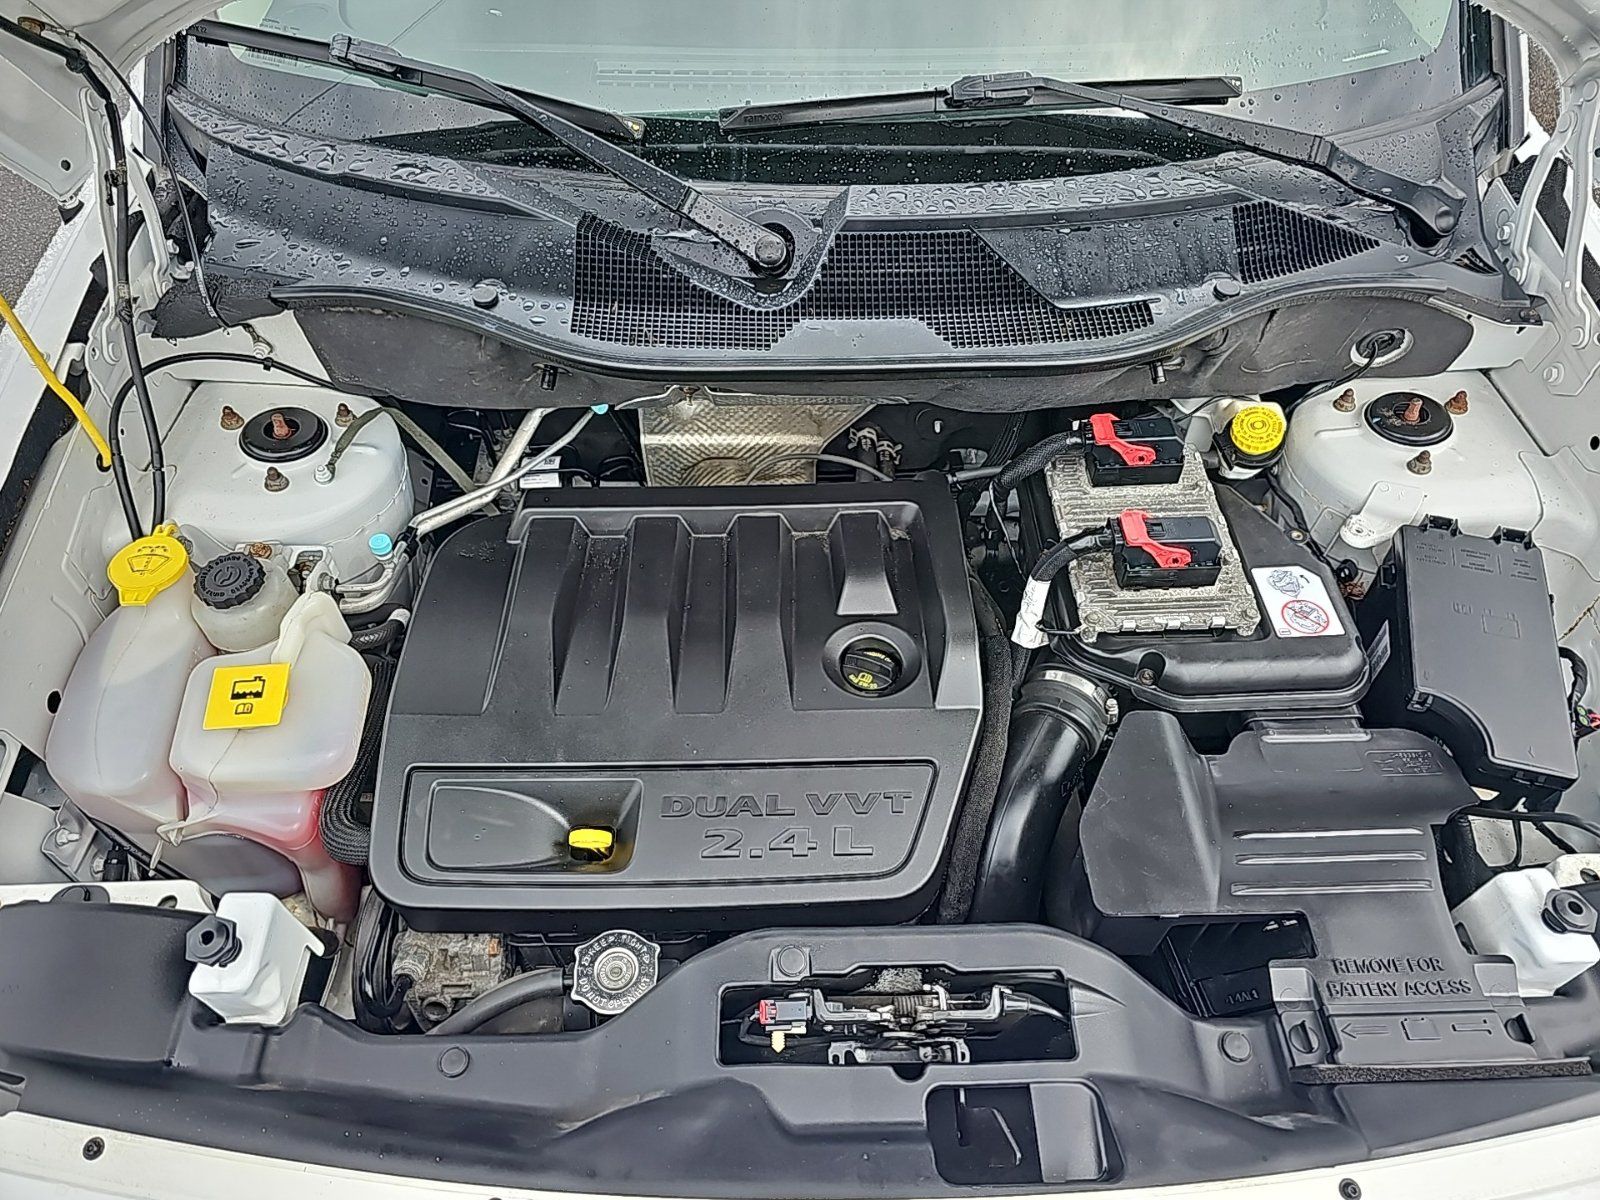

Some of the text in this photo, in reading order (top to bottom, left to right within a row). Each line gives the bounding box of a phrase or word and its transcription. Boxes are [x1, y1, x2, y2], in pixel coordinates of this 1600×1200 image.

[660, 791, 913, 818] DUAL VVT
[589, 934, 648, 956] KEEP TIGHT
[1331, 956, 1444, 974] REMOVE FOR
[1326, 978, 1473, 998] BATTERY ACCESS
